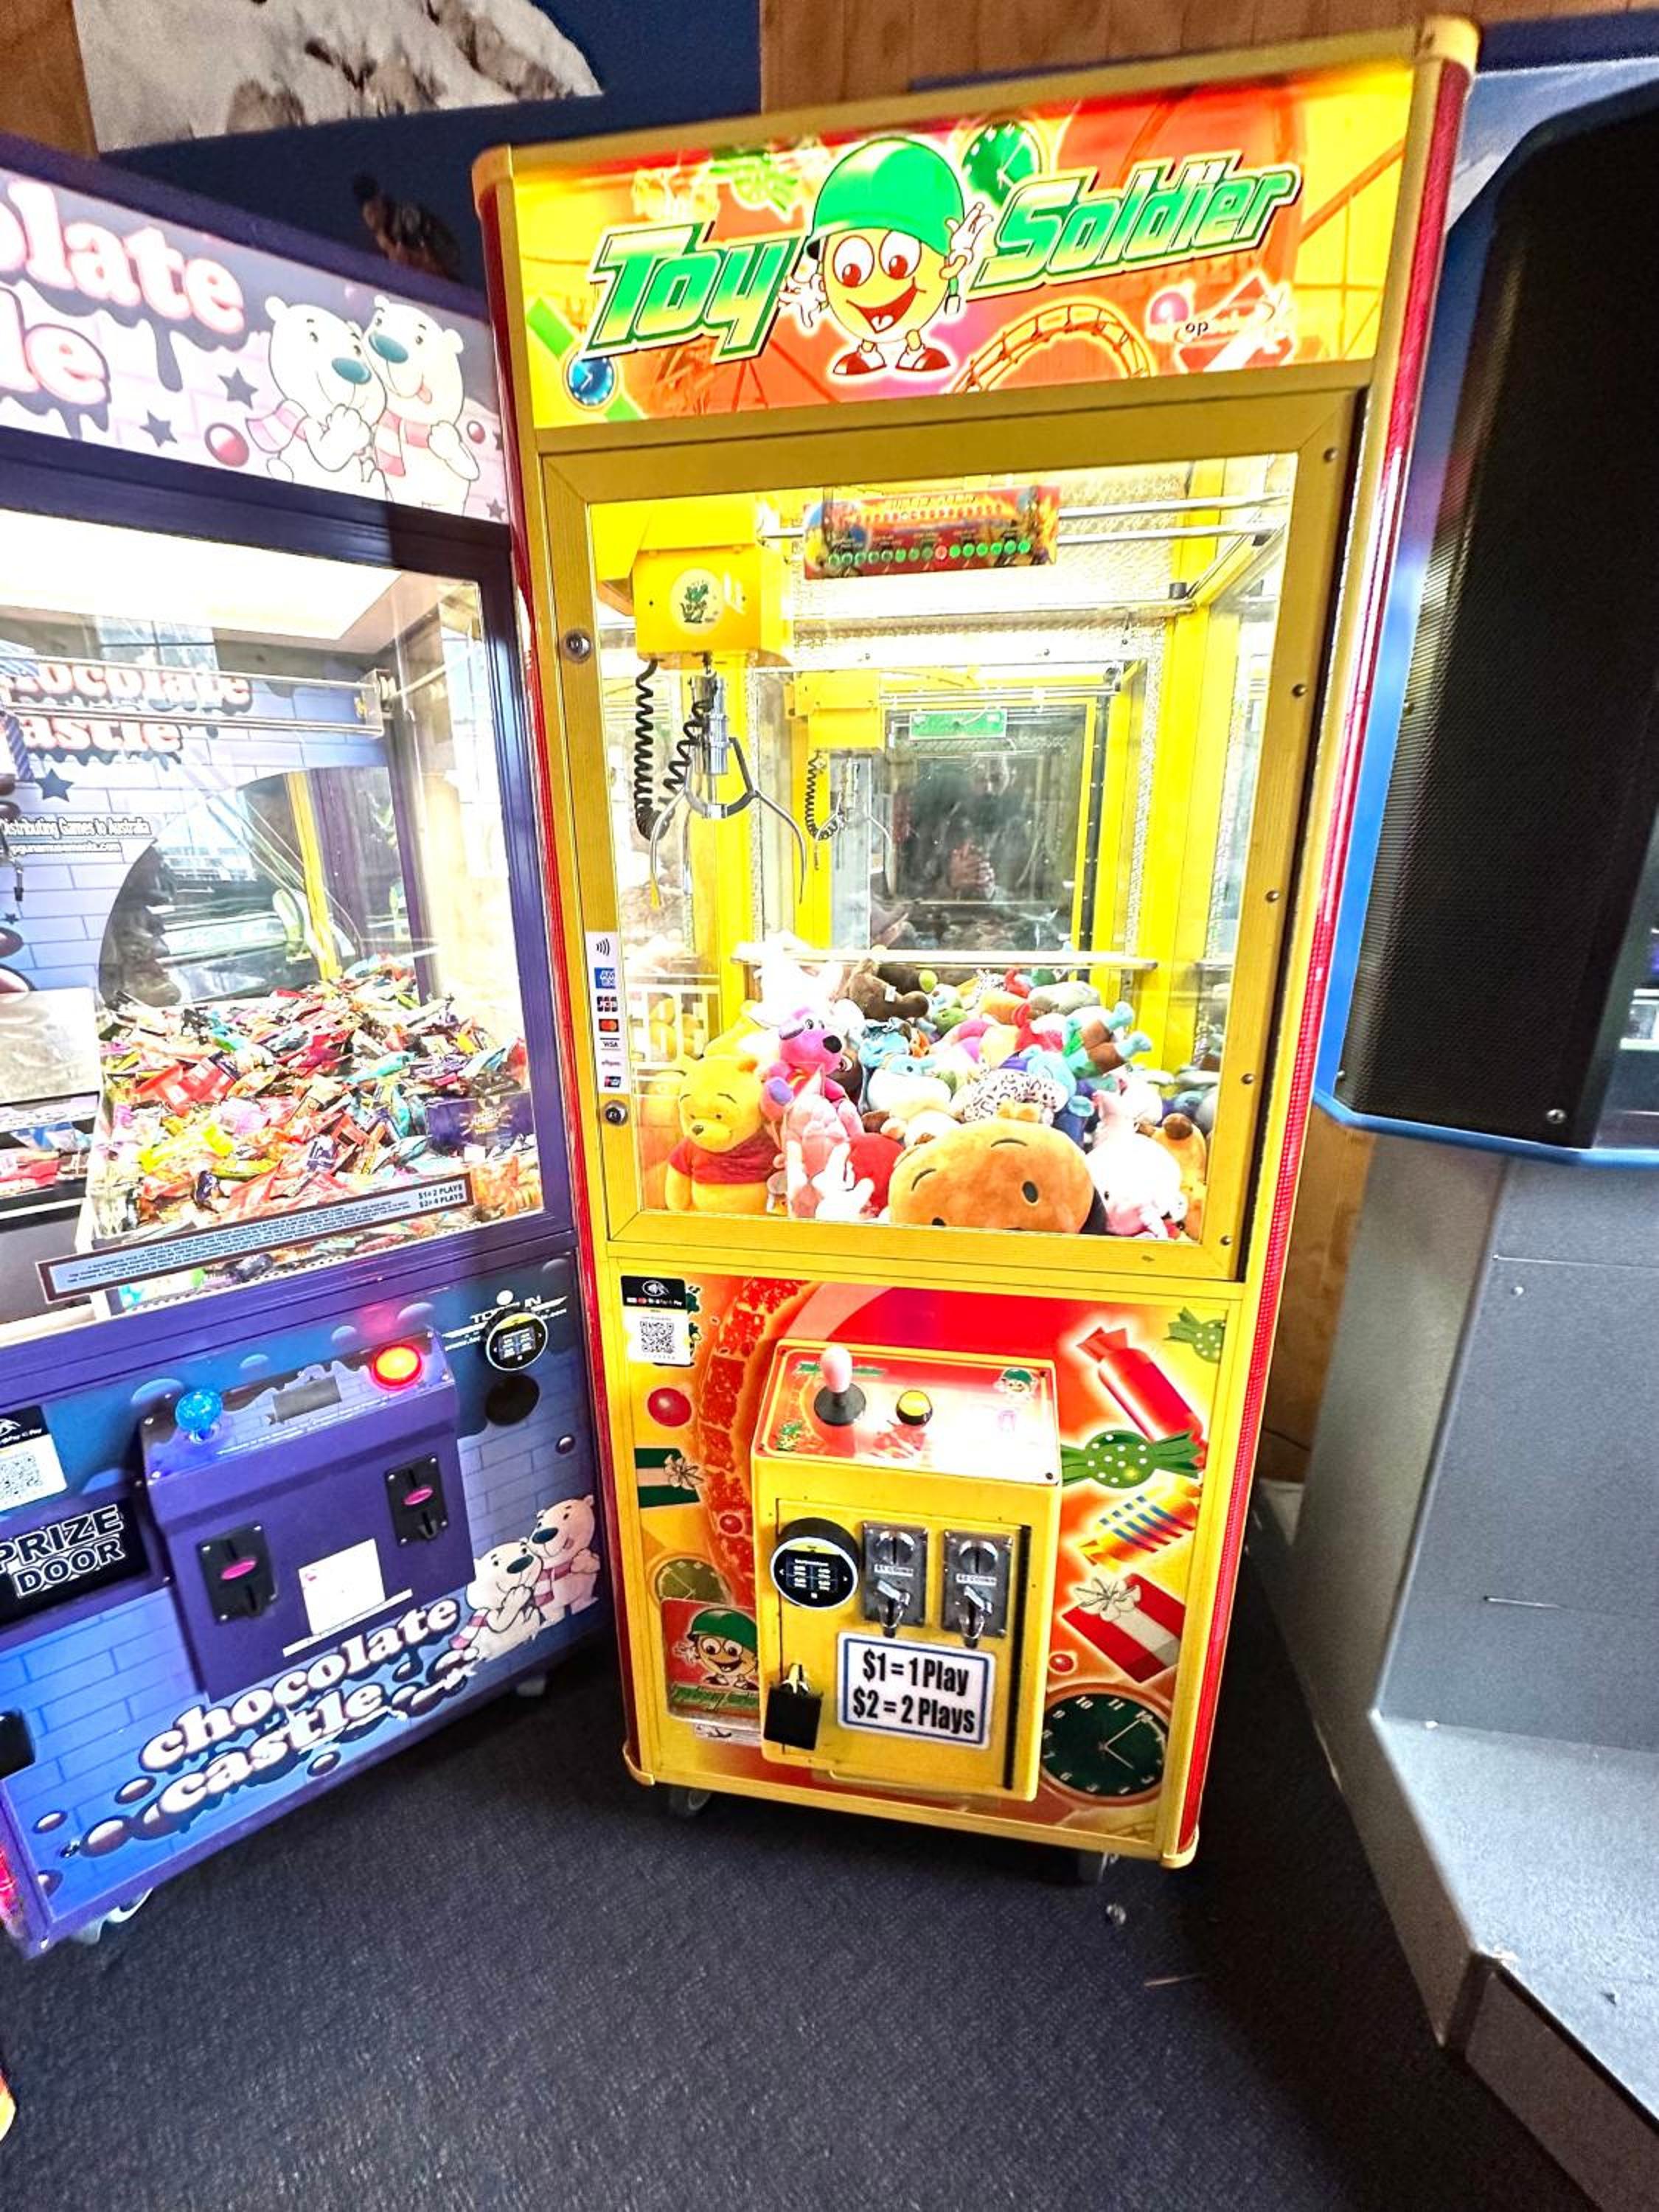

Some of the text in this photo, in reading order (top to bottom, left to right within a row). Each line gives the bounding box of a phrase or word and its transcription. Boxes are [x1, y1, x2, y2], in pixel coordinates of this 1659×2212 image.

[585, 153, 1301, 361] Toy Soldier
[439, 1184, 462, 1194] PLAYS
[440, 1193, 464, 1203] PLAYS
[0, 1503, 124, 1573] PRIZE
[14, 1536, 126, 1598] DOOR
[139, 1596, 459, 1771] chocolate
[922, 1658, 970, 1697] Play
[901, 1694, 914, 1725] 2
[918, 1697, 976, 1734] Plays
[158, 1683, 386, 1815] castle
